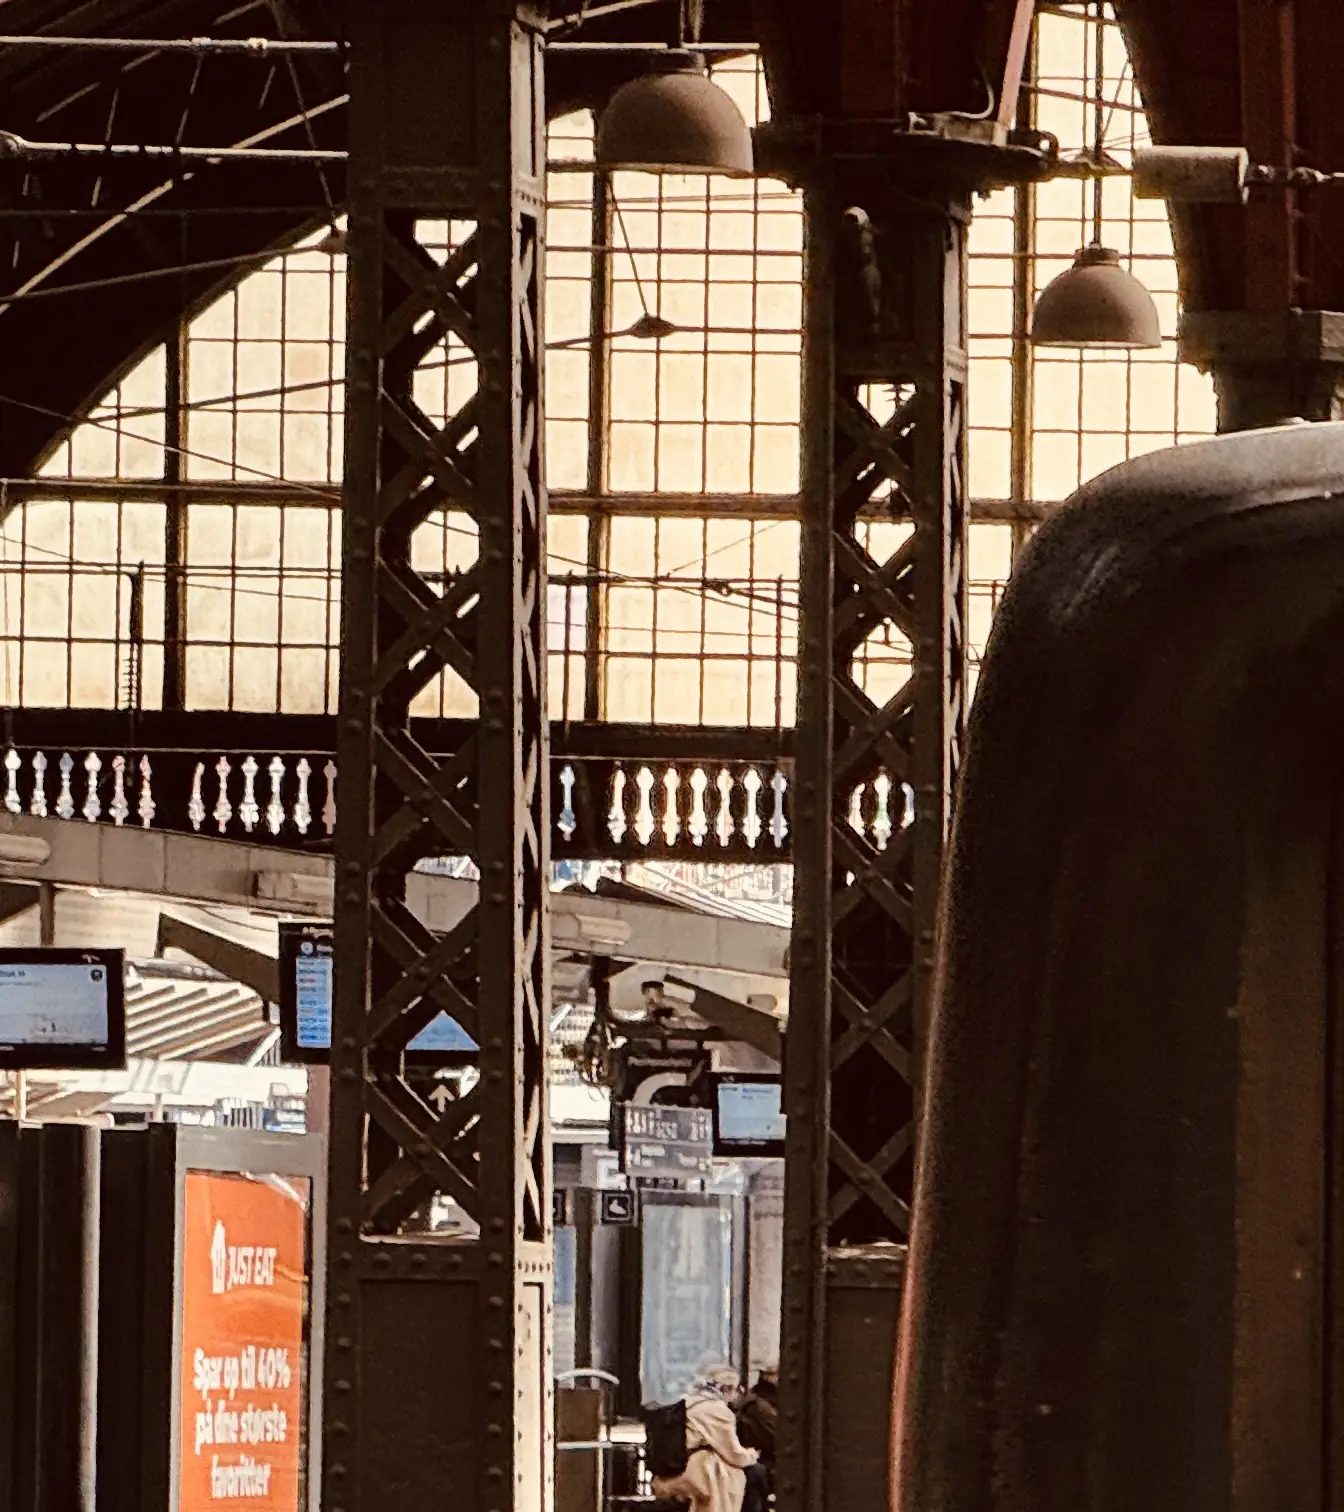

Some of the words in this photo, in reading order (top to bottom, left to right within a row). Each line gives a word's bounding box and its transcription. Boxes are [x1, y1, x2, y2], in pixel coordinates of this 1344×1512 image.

[227, 1246, 255, 1291] JUST
[254, 1246, 277, 1286] EAT
[193, 1347, 222, 1401] Spar
[223, 1356, 240, 1401] op
[241, 1345, 256, 1390] til
[257, 1347, 292, 1389] 40%
[194, 1398, 214, 1456] på
[211, 1453, 272, 1499] favoritter
